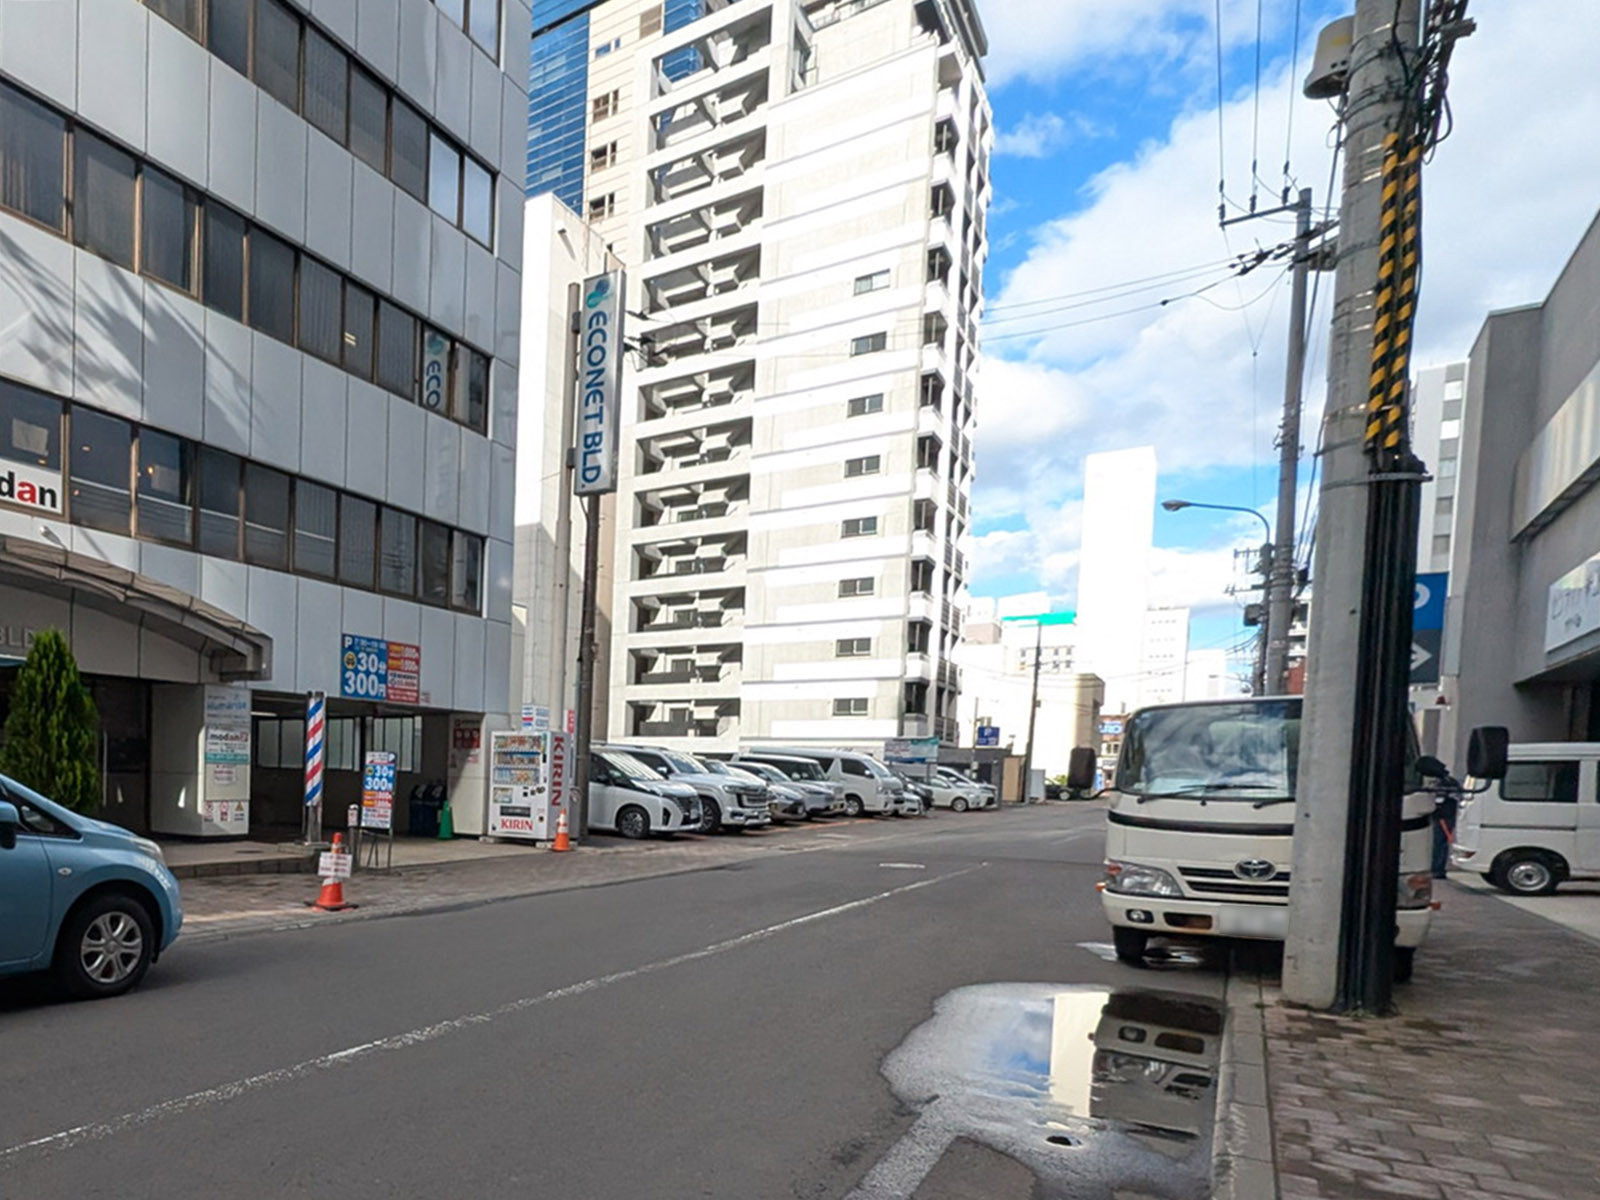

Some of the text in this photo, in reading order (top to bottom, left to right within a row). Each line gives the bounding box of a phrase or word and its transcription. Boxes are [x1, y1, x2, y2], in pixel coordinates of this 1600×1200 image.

[584, 310, 608, 425] ECONET
[0, 470, 57, 509] dan
[344, 636, 353, 649] P
[551, 736, 565, 806] KIRIN
[501, 818, 533, 831] KIRIN
